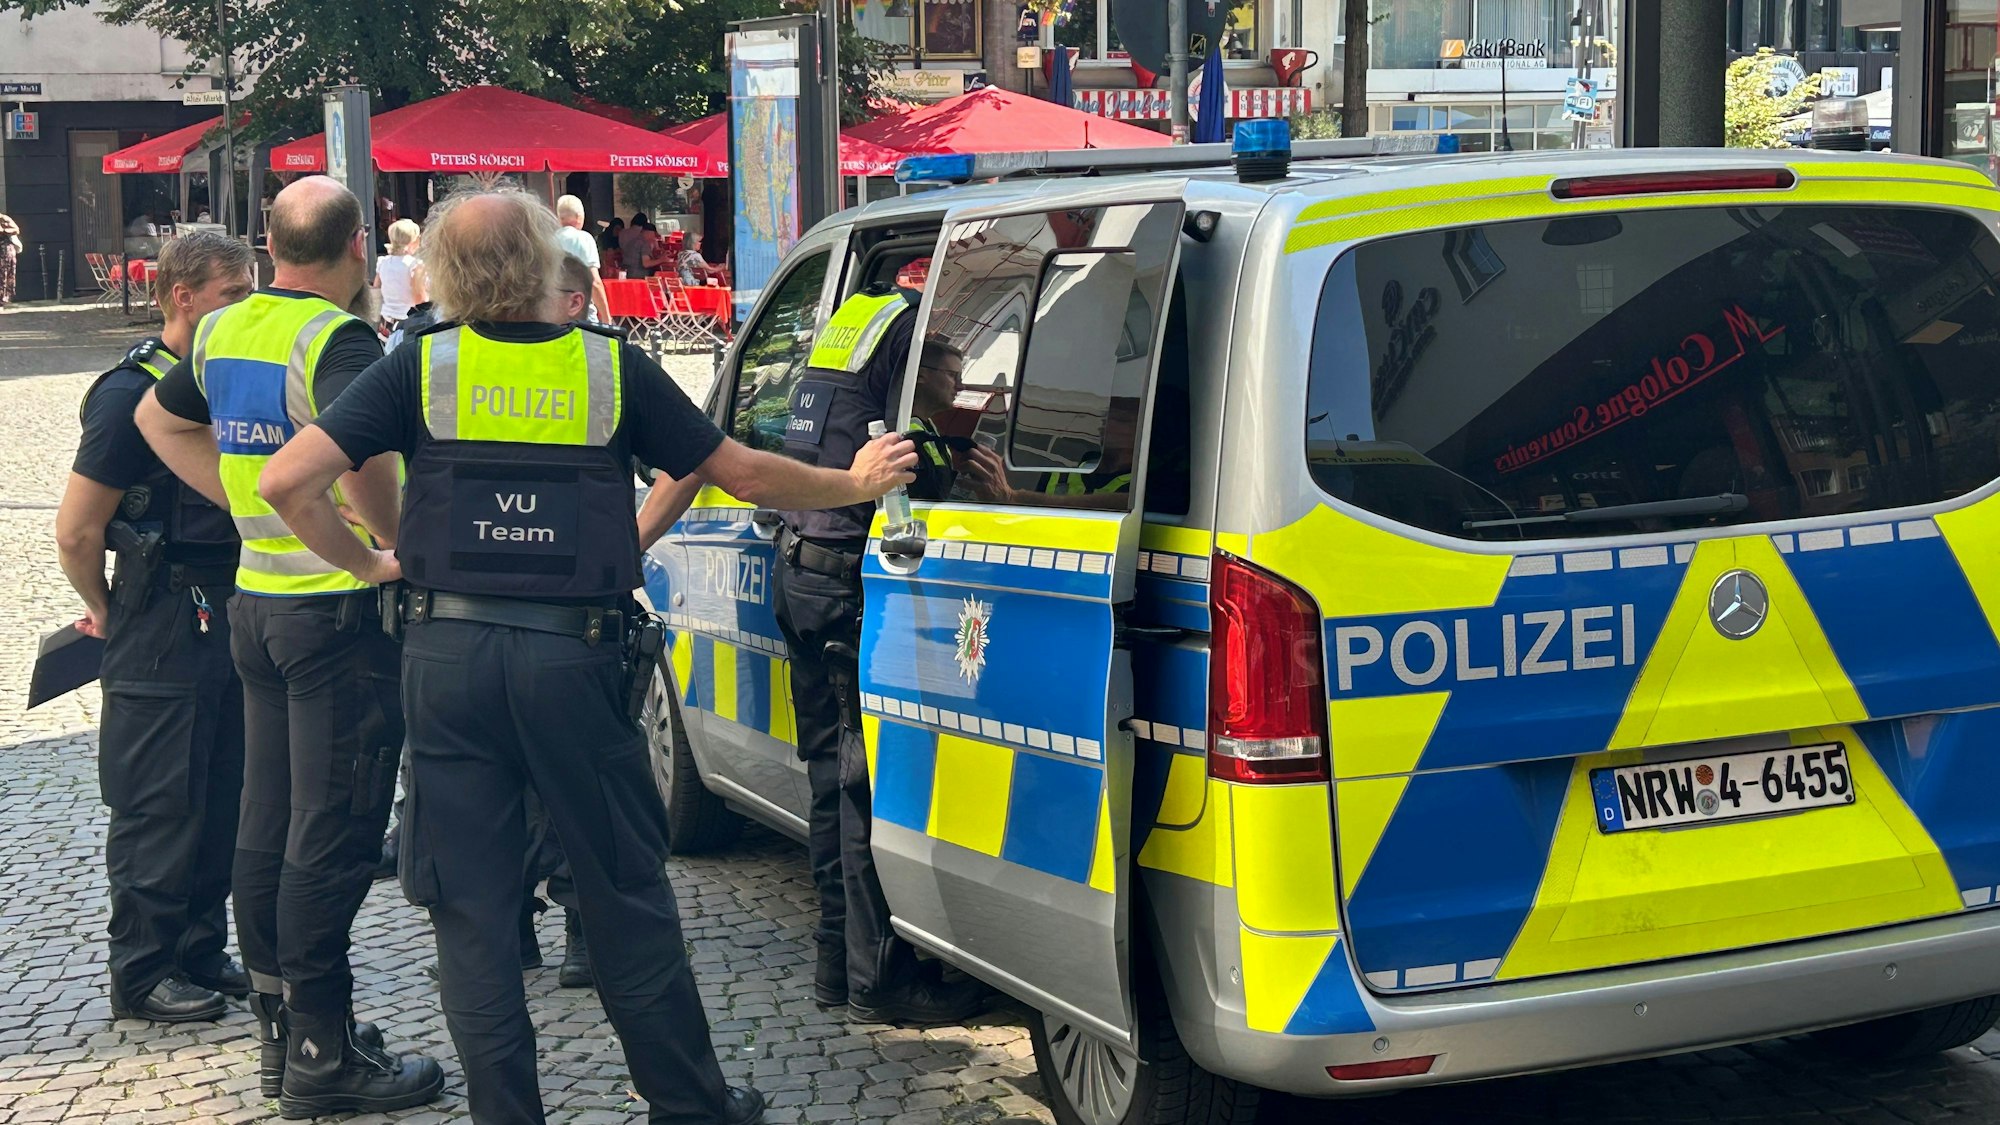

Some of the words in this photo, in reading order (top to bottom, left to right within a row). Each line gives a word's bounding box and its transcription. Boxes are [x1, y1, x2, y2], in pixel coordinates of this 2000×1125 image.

[1467, 60, 1531, 68] INTERNAIONAL
[15, 131, 34, 139] ATM
[430, 152, 477, 166] PETERS
[479, 153, 525, 167] KÖLSCH
[609, 153, 653, 167] PETERS
[655, 154, 698, 168] KÖLSCH
[471, 384, 576, 421] POLIZEI
[800, 392, 815, 409] VU
[214, 419, 286, 445] U-TEAM
[786, 414, 814, 432] Team
[495, 492, 537, 514] VU
[473, 520, 555, 543] Team
[705, 550, 766, 605] POLIZEI
[1335, 603, 1636, 691] POLIZEI
[1617, 766, 1696, 823] NRW
[1719, 749, 1849, 809] 4-6455
[1603, 807, 1615, 821] D
